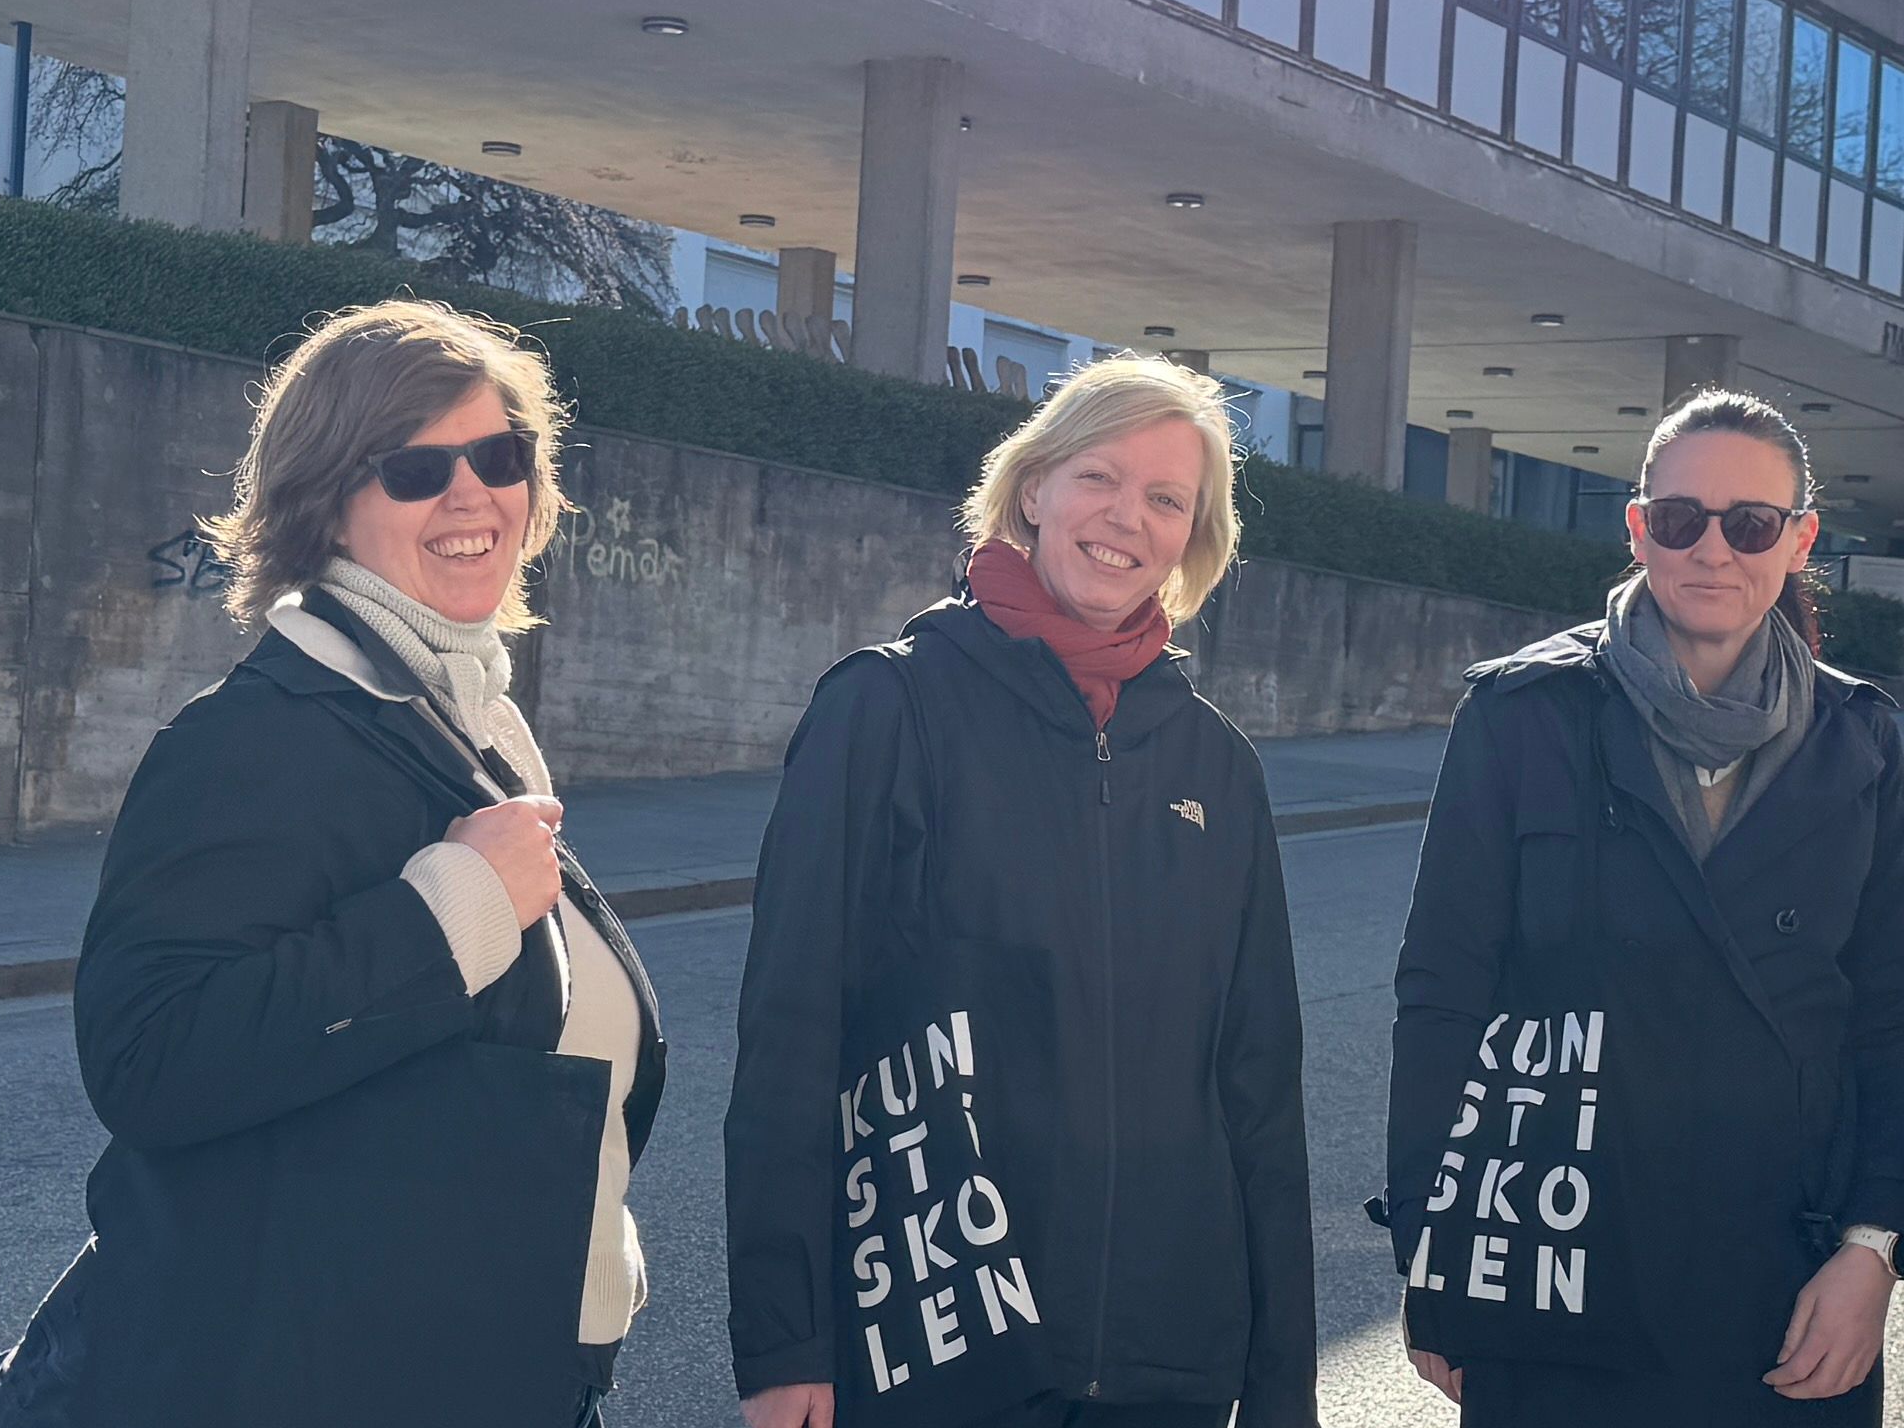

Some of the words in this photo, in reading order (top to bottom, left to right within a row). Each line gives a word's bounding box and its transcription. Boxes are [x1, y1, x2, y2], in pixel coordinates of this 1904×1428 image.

[840, 1010, 975, 1153] KUN
[852, 1174, 1009, 1309] SKO
[1426, 1150, 1591, 1232] SKO
[864, 1257, 1041, 1393] LEN
[1408, 1225, 1587, 1315] LEN
